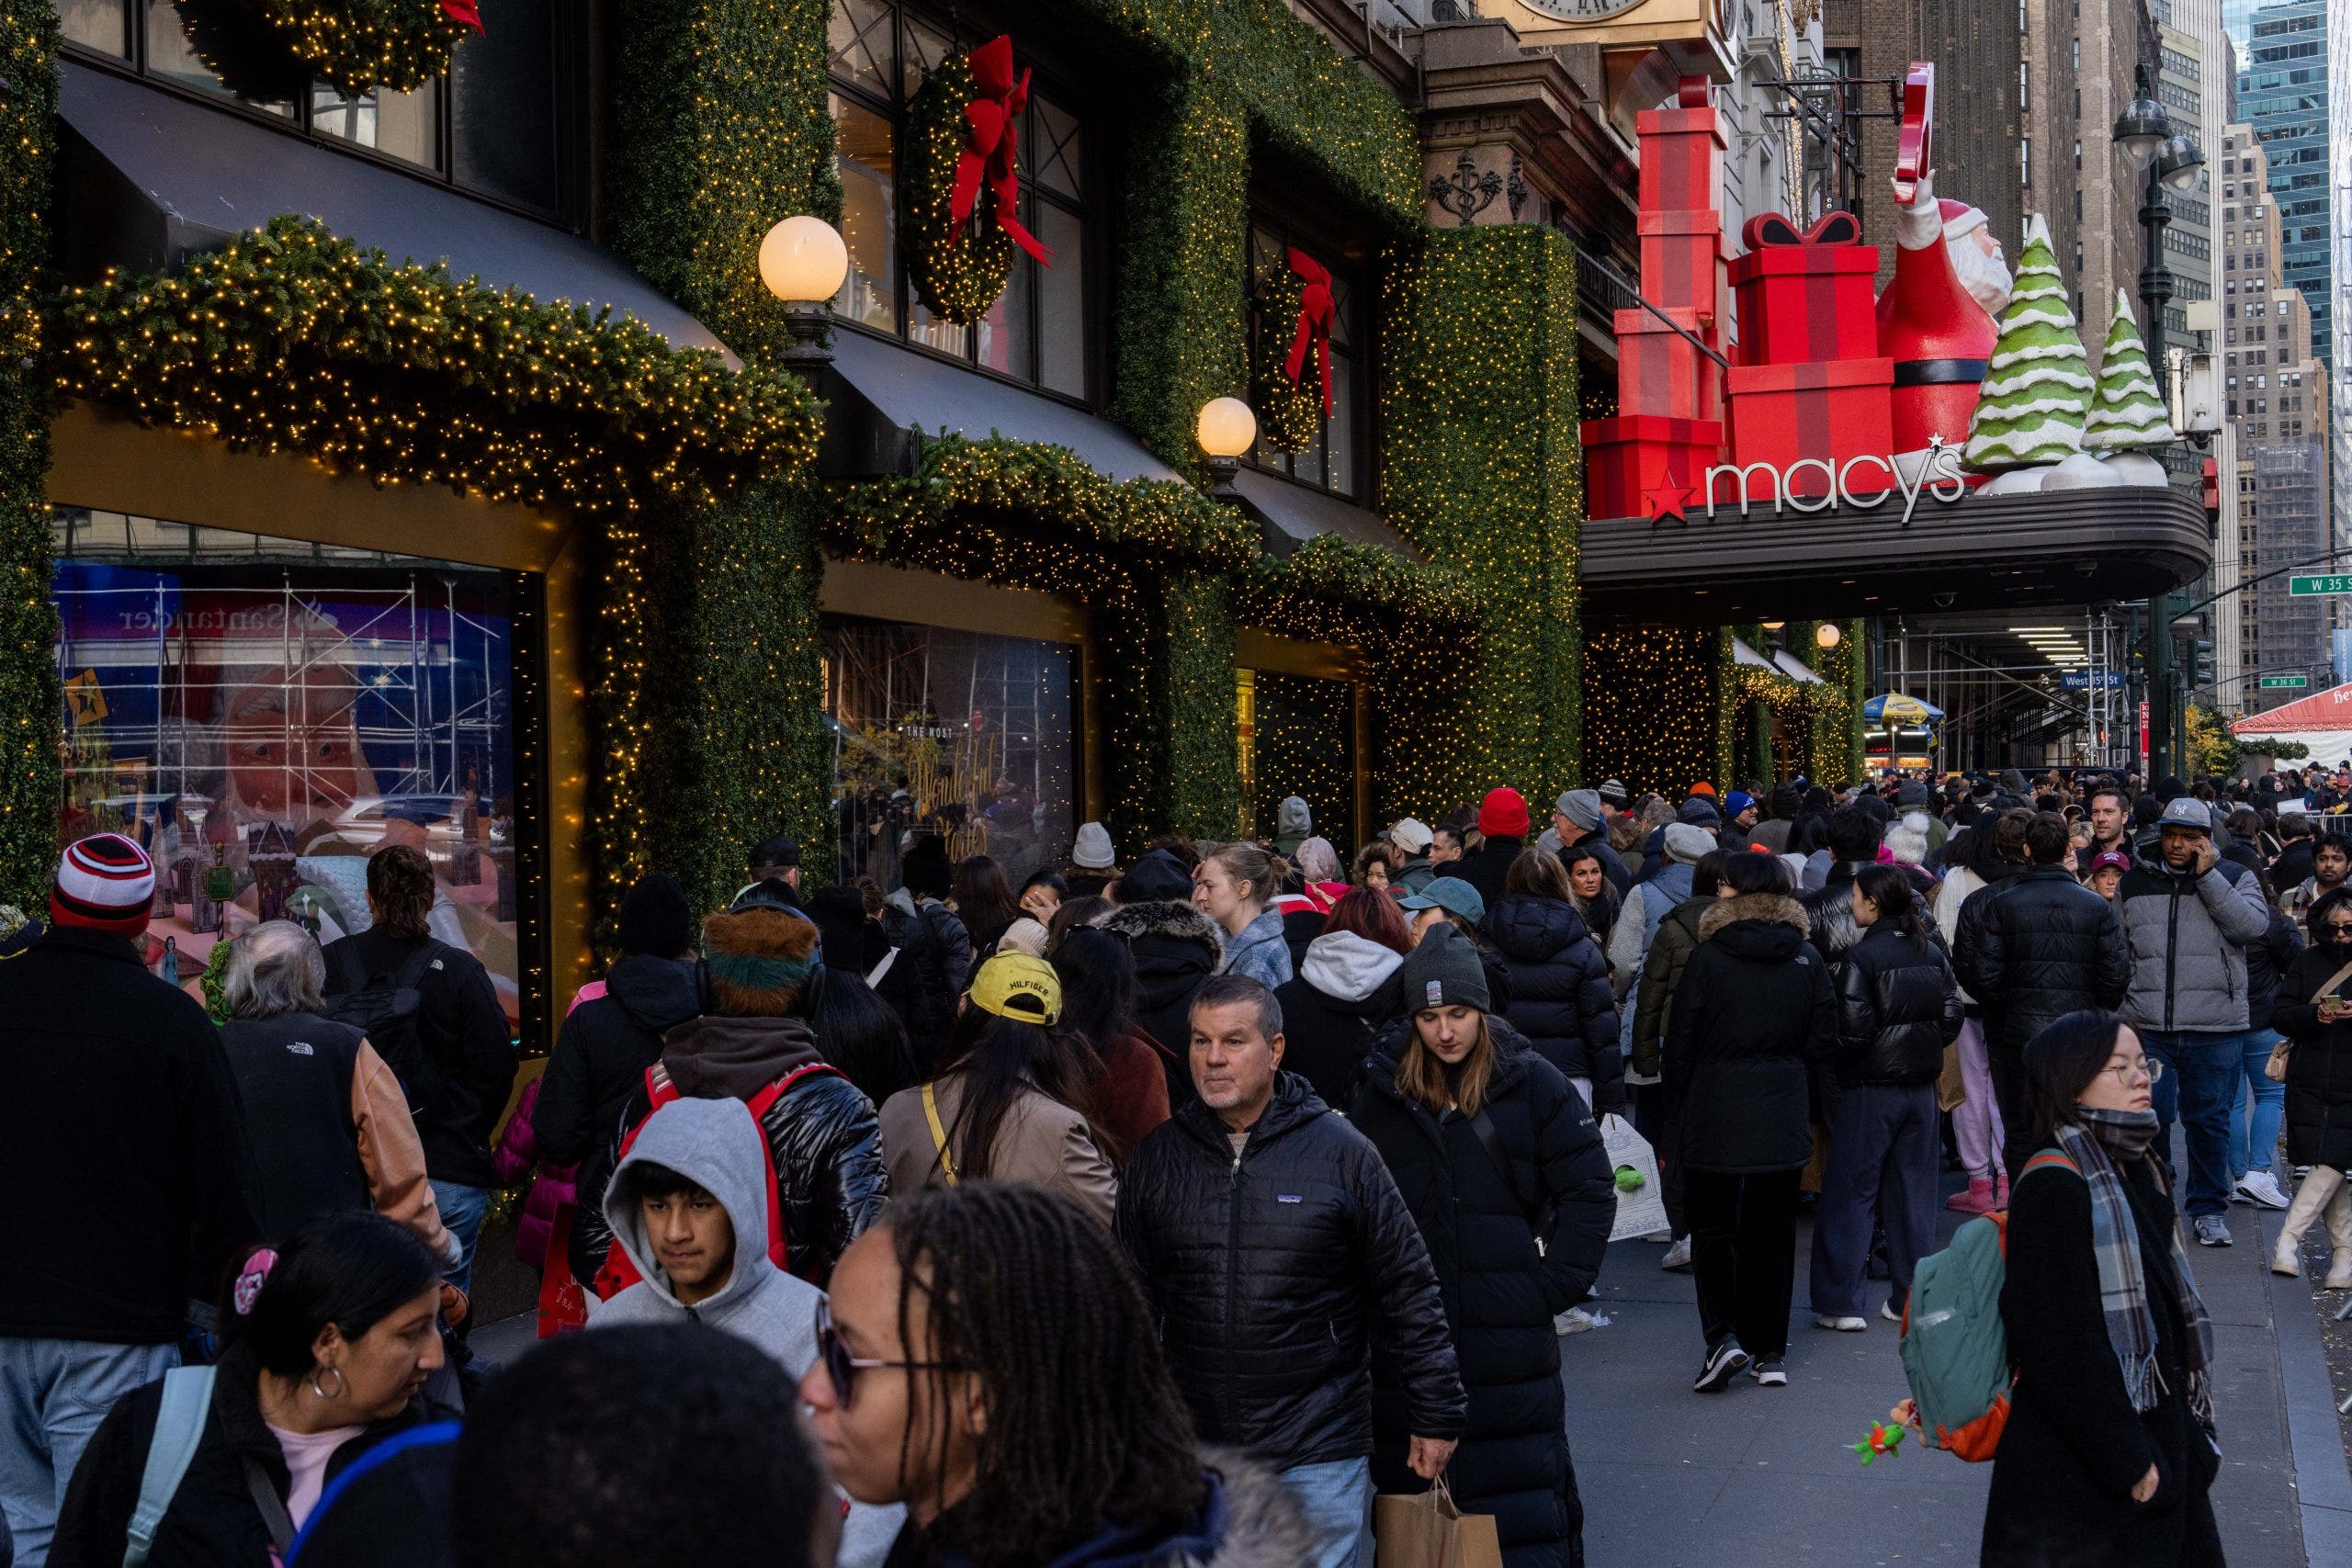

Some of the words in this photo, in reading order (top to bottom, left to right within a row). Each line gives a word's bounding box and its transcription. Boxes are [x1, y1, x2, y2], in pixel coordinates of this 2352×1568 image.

[2312, 579, 2323, 591] W
[2328, 579, 2342, 591] 35
[2065, 676, 2088, 685] West
[2109, 675, 2119, 684] St
[907, 726, 924, 738] THE
[929, 727, 953, 739] MOST
[1010, 980, 1048, 996] HILFIGER
